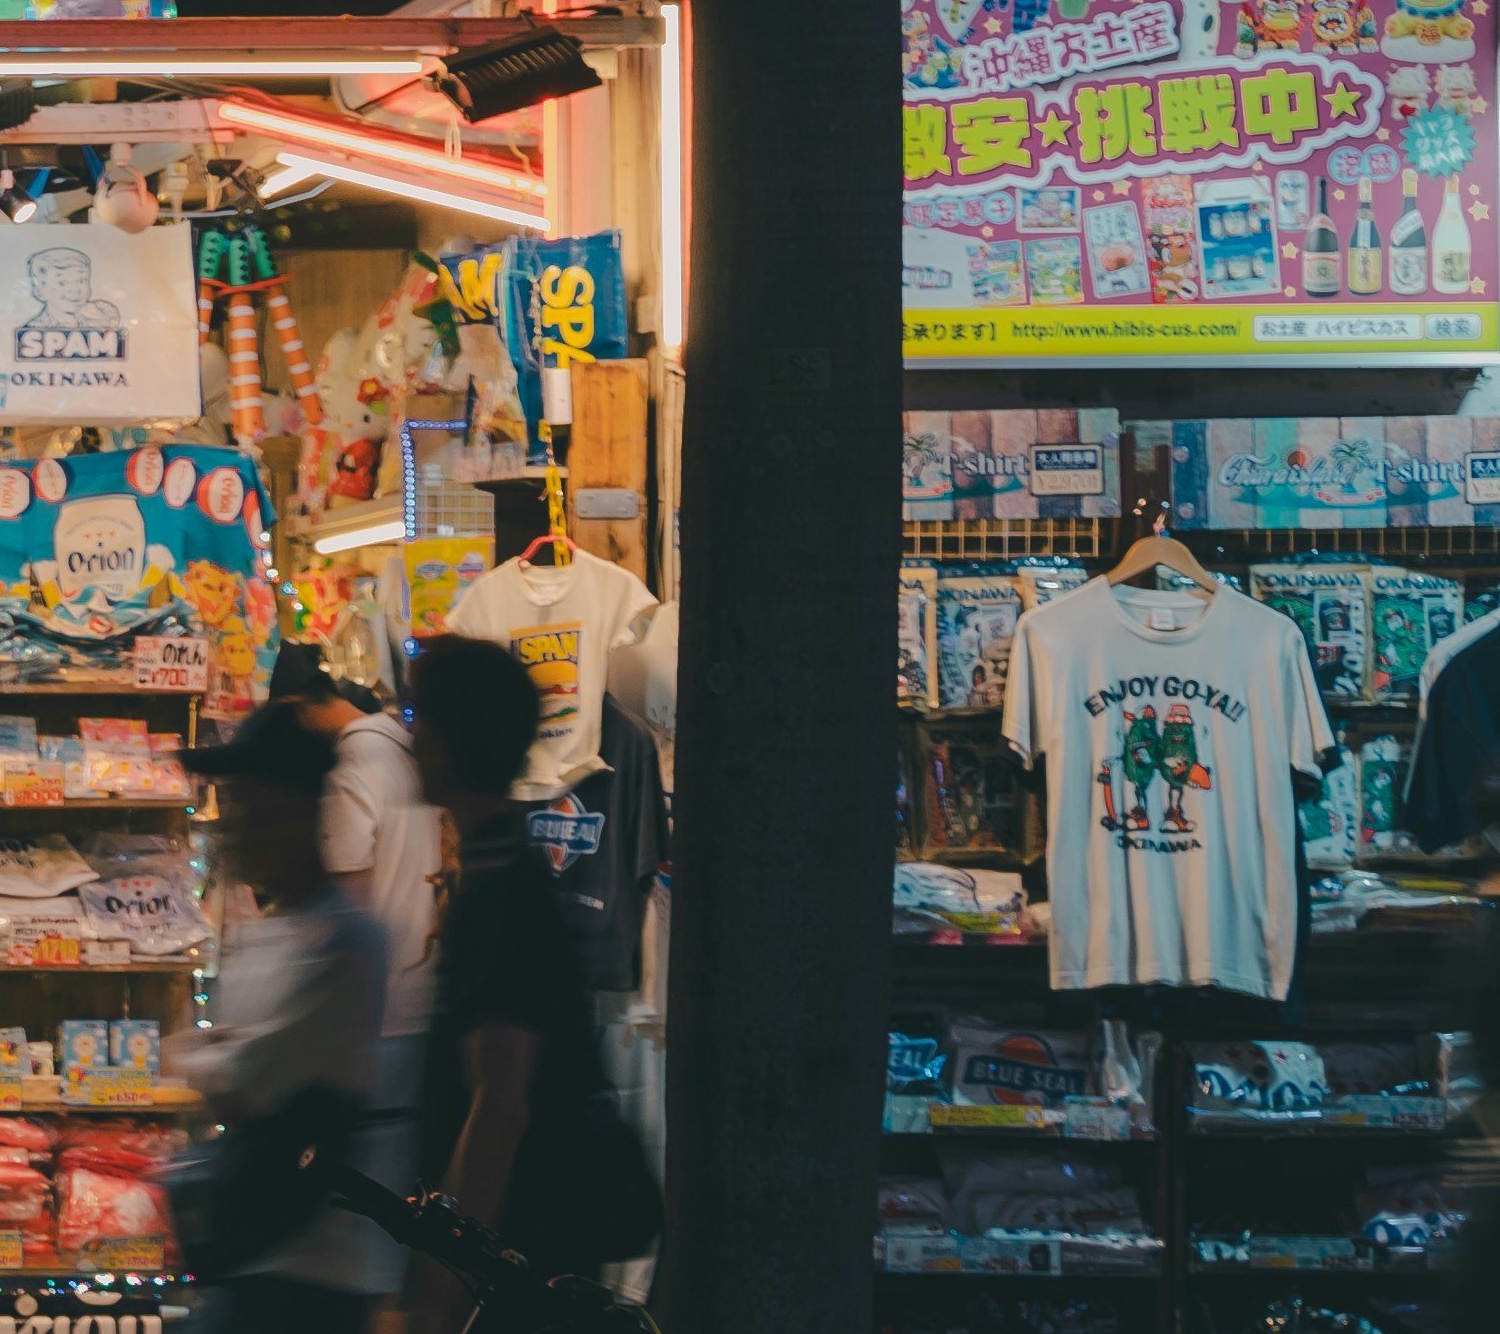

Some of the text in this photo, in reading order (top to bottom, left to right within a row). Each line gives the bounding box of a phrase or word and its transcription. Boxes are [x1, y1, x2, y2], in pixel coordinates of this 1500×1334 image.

[1011, 317, 1242, 340] http://www.hibis-cus.com/
[19, 330, 119, 358] SPAM
[11, 372, 130, 388] OKINAWA
[938, 454, 1030, 478] T-shirt
[67, 543, 136, 575] Orion
[1263, 571, 1362, 590] OKINAWA
[1083, 676, 1160, 718] ENJOY
[972, 1061, 1081, 1094] BLUE SEAL
